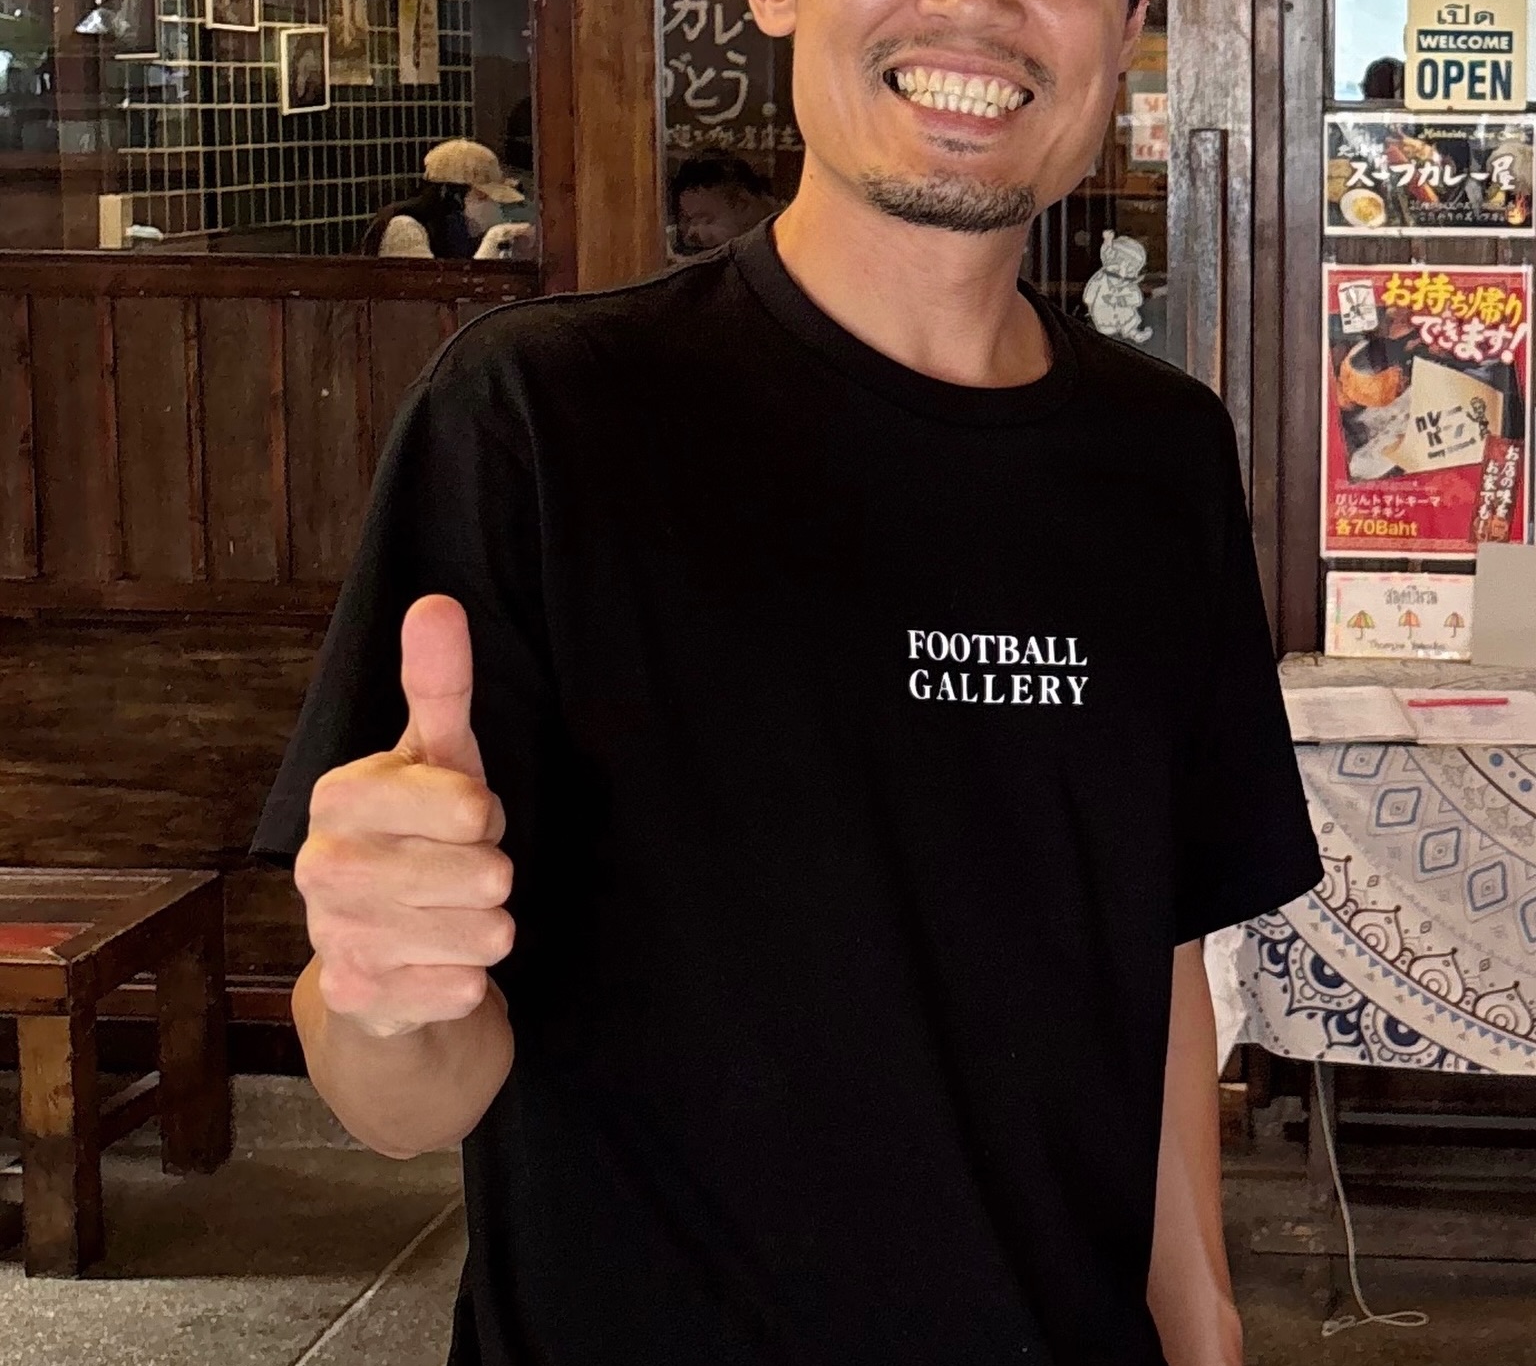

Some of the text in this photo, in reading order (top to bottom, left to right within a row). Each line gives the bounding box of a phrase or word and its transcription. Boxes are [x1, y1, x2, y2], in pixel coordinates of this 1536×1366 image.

[1436, 3, 1495, 26] เปิด
[1419, 33, 1510, 51] WELCOME
[1417, 58, 1513, 101] OPEN
[1381, 271, 1523, 327] お持ち帰り
[906, 629, 1088, 666] FOOTBALL
[908, 669, 1089, 705] GALLERY
